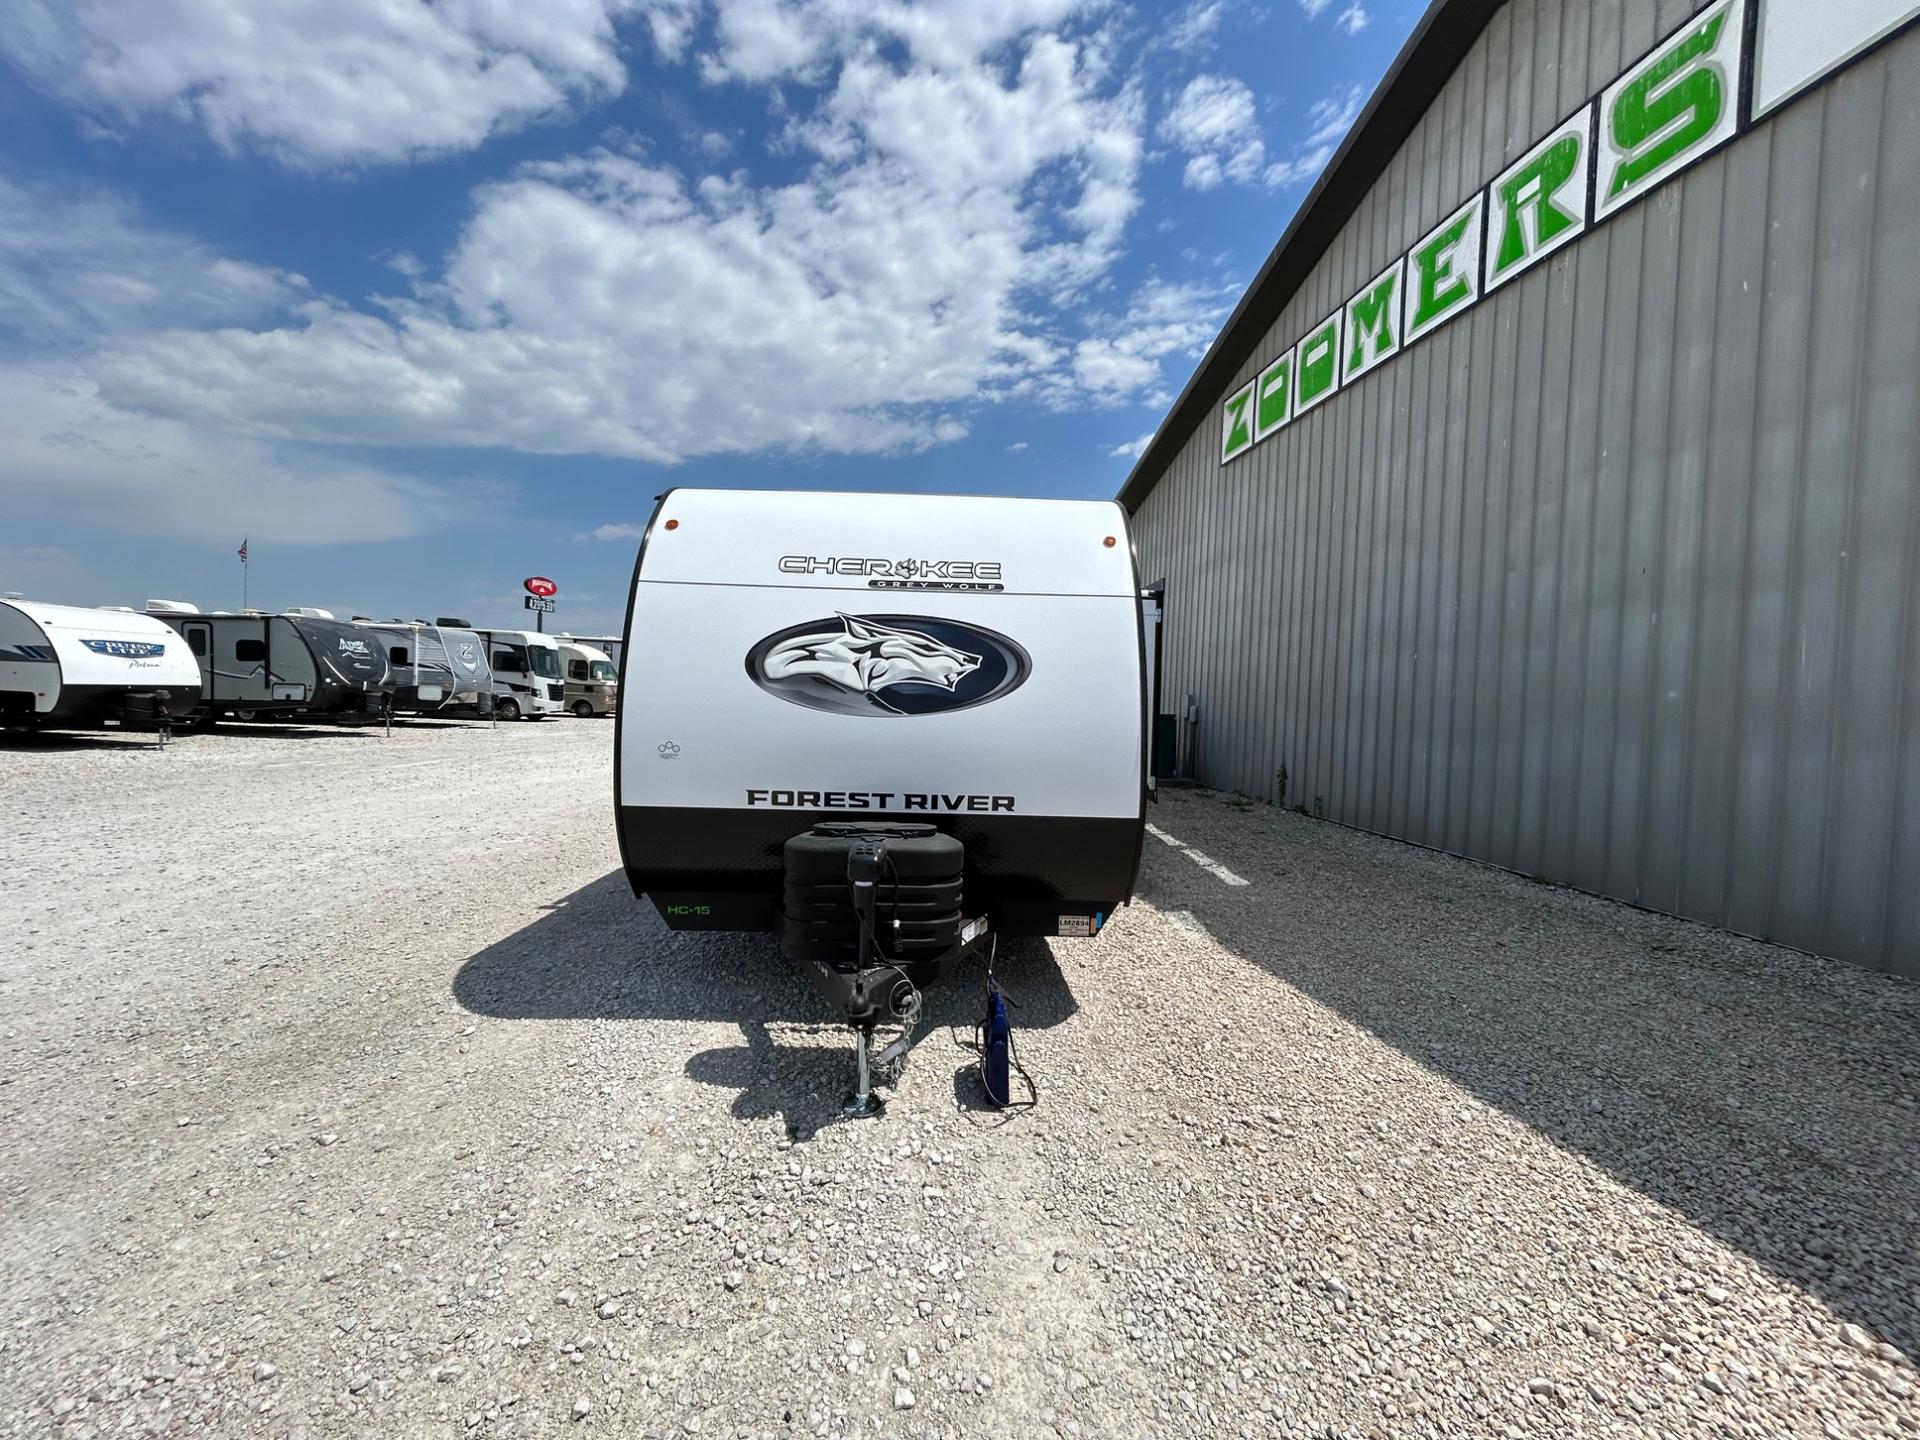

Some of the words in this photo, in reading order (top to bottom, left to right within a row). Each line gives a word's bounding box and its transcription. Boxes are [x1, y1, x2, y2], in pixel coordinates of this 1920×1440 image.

[1223, 1, 1731, 459] ZOOMERS
[876, 580, 929, 589] GREY
[942, 583, 998, 591] WOLF
[746, 789, 895, 809] FOREST
[903, 793, 1015, 812] RIVER
